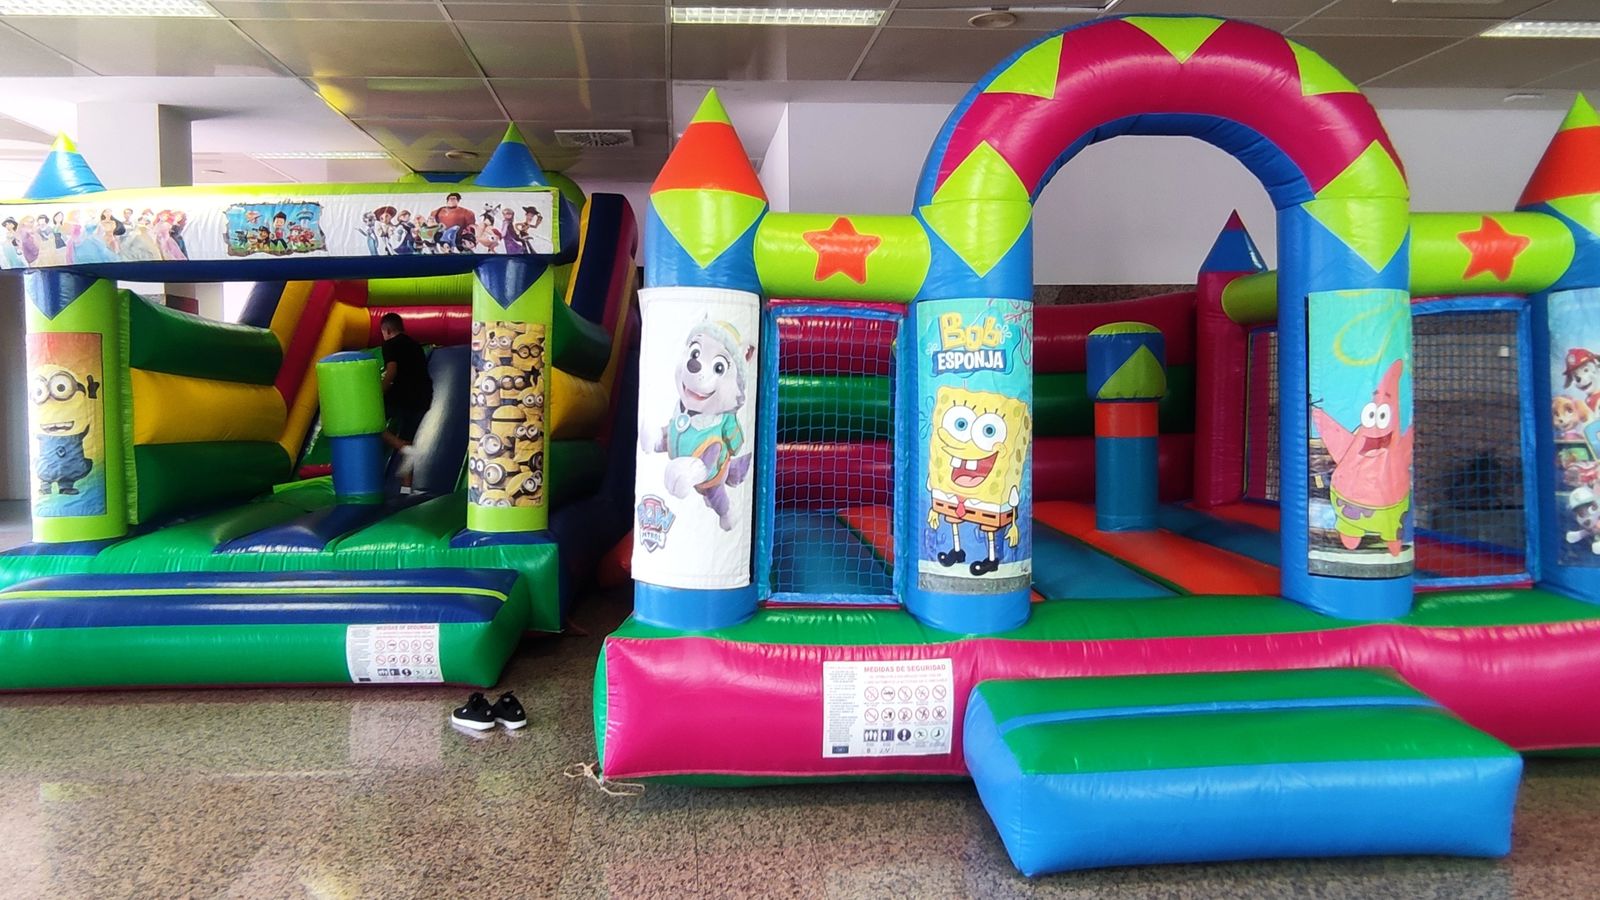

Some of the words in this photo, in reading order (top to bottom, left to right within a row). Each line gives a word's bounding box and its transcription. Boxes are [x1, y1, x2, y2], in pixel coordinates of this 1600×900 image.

[939, 312, 1001, 351] Bob
[937, 350, 1004, 370] ESPONJA
[864, 665, 895, 673] MEDIDAS
[907, 664, 946, 672] SEGURIDAD
